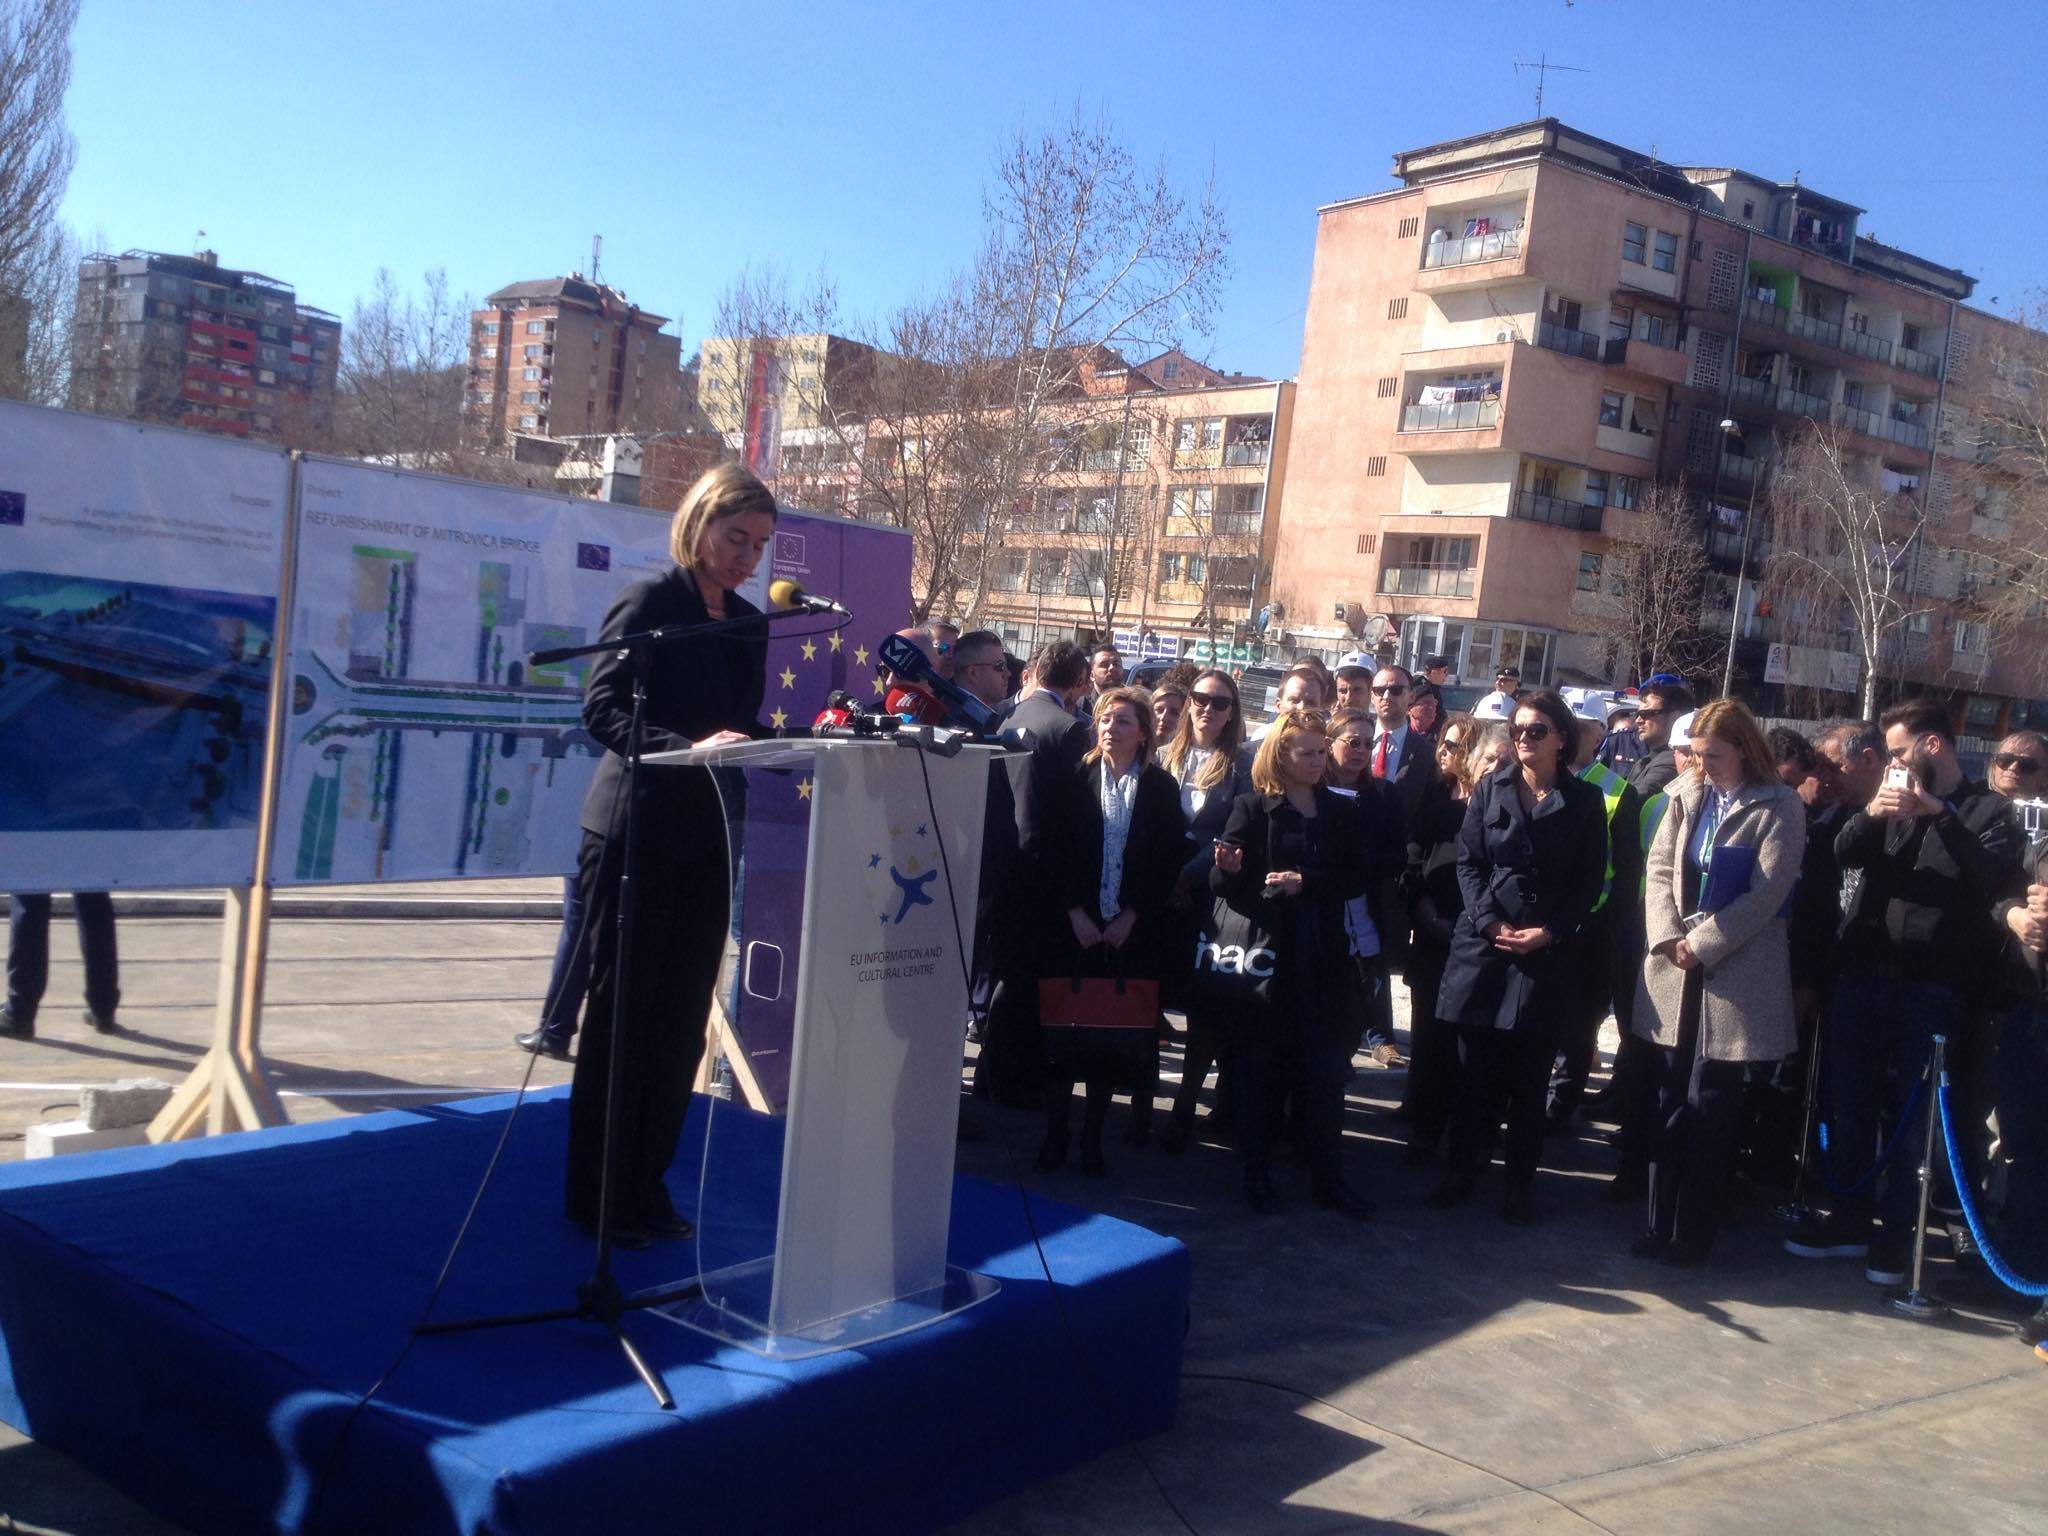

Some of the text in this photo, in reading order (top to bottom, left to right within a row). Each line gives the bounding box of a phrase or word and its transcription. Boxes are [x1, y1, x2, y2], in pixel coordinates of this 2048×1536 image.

[306, 510, 542, 554] REFURBISHMENT OF MITROVICA BRIDGE
[773, 563, 797, 573] European
[850, 946, 943, 966] EU INFORMATION AND
[858, 963, 935, 982] CULTURAL CENTRE
